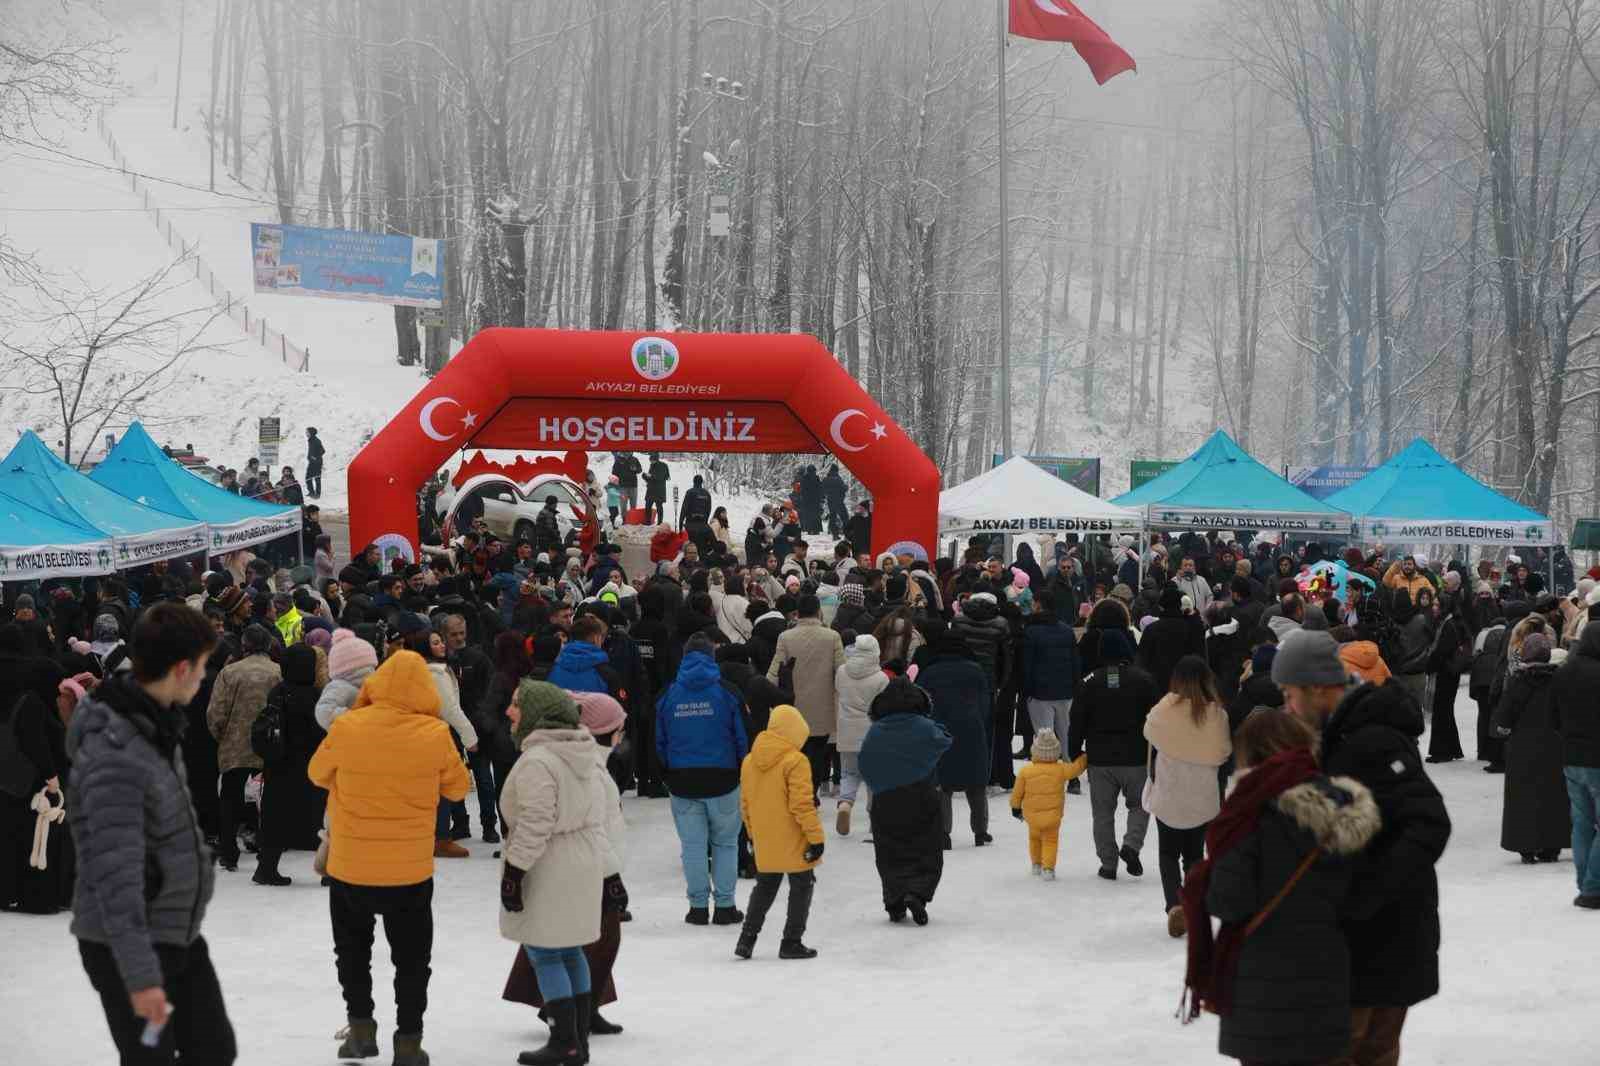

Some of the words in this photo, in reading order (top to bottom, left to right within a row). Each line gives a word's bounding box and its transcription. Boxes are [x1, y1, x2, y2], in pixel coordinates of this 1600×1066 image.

[585, 381, 636, 393] AKYAZI
[639, 383, 721, 394] BELEDİYESİ
[538, 411, 756, 447] HOŞGELDİNİZ
[973, 518, 1024, 530] AKYAZI
[1029, 516, 1113, 530] BELEDİYESİ
[1192, 516, 1235, 527] AKYAZI
[1399, 526, 1442, 537] AKYAZI
[1445, 525, 1514, 539] BELEDİYESİ
[16, 552, 45, 569] AKYAZI
[45, 549, 92, 568] BELEDİYESİ
